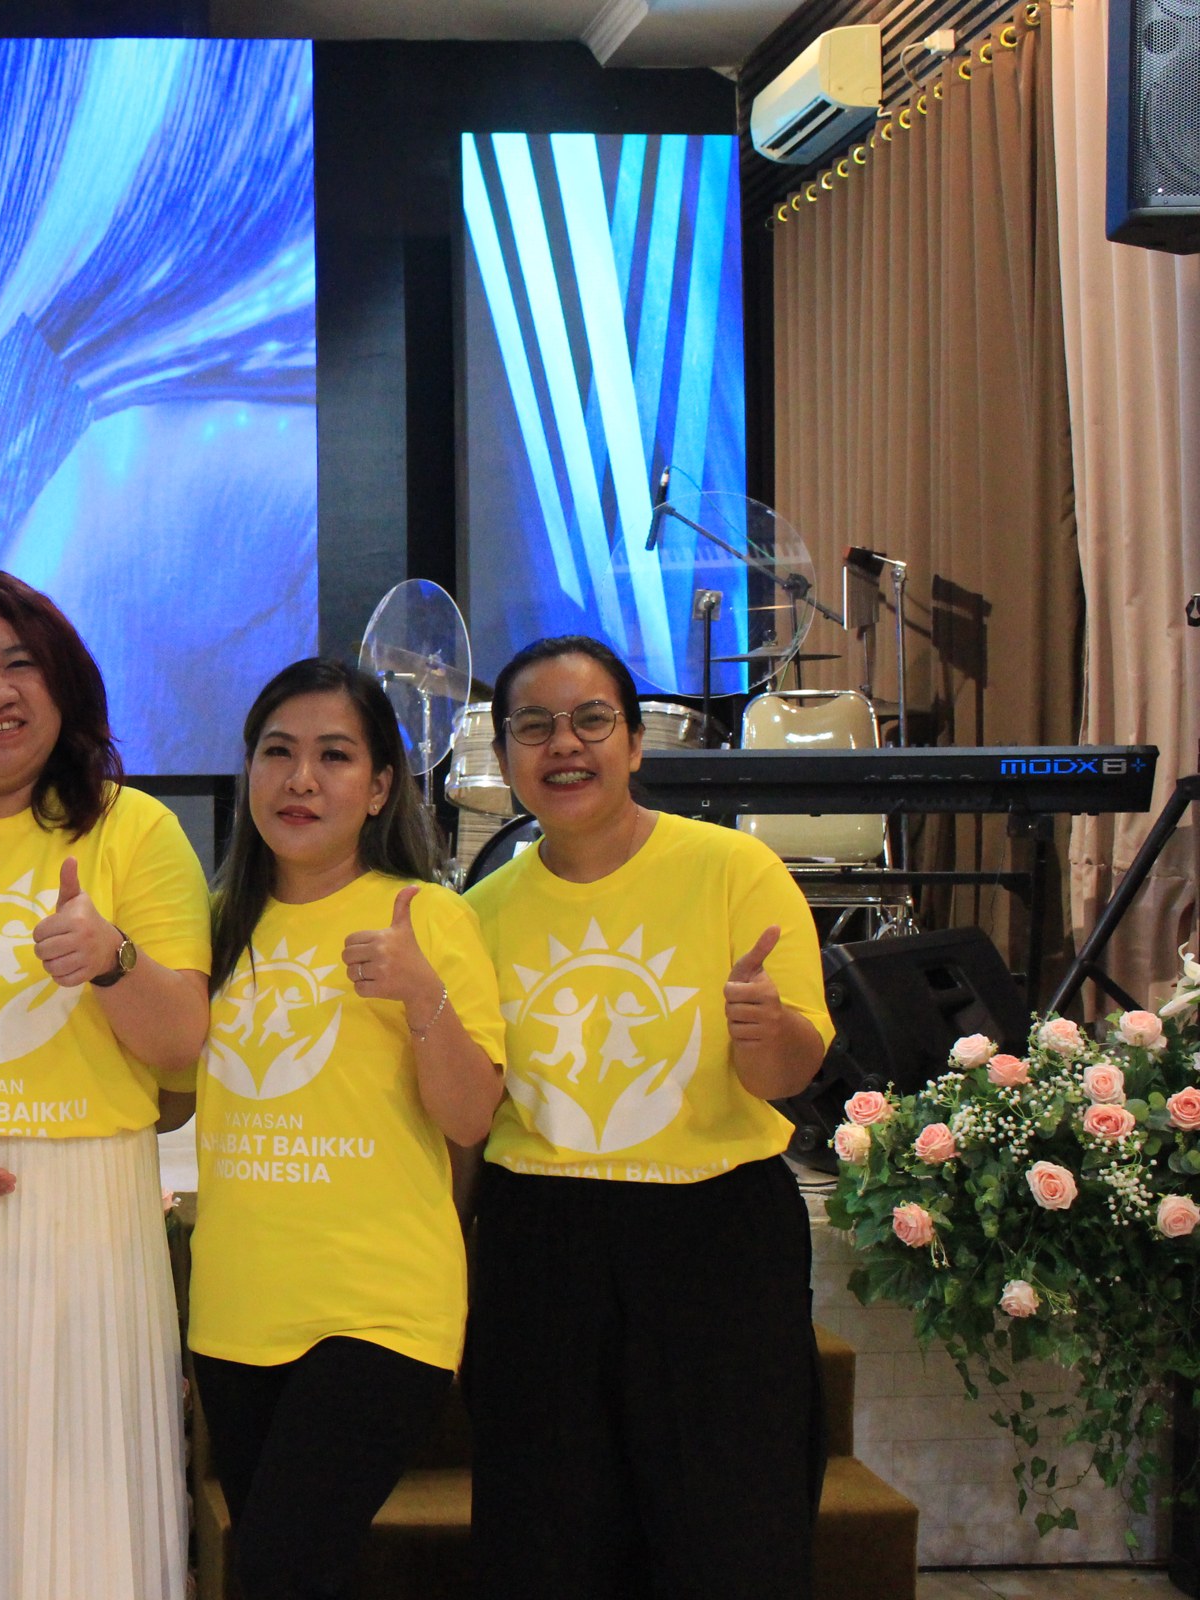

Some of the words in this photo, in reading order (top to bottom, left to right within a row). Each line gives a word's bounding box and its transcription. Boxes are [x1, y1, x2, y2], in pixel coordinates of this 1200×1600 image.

[224, 1111, 303, 1129] YAYASAN
[273, 1136, 375, 1158] BAIKKU
[214, 1159, 331, 1183] NDONESIA
